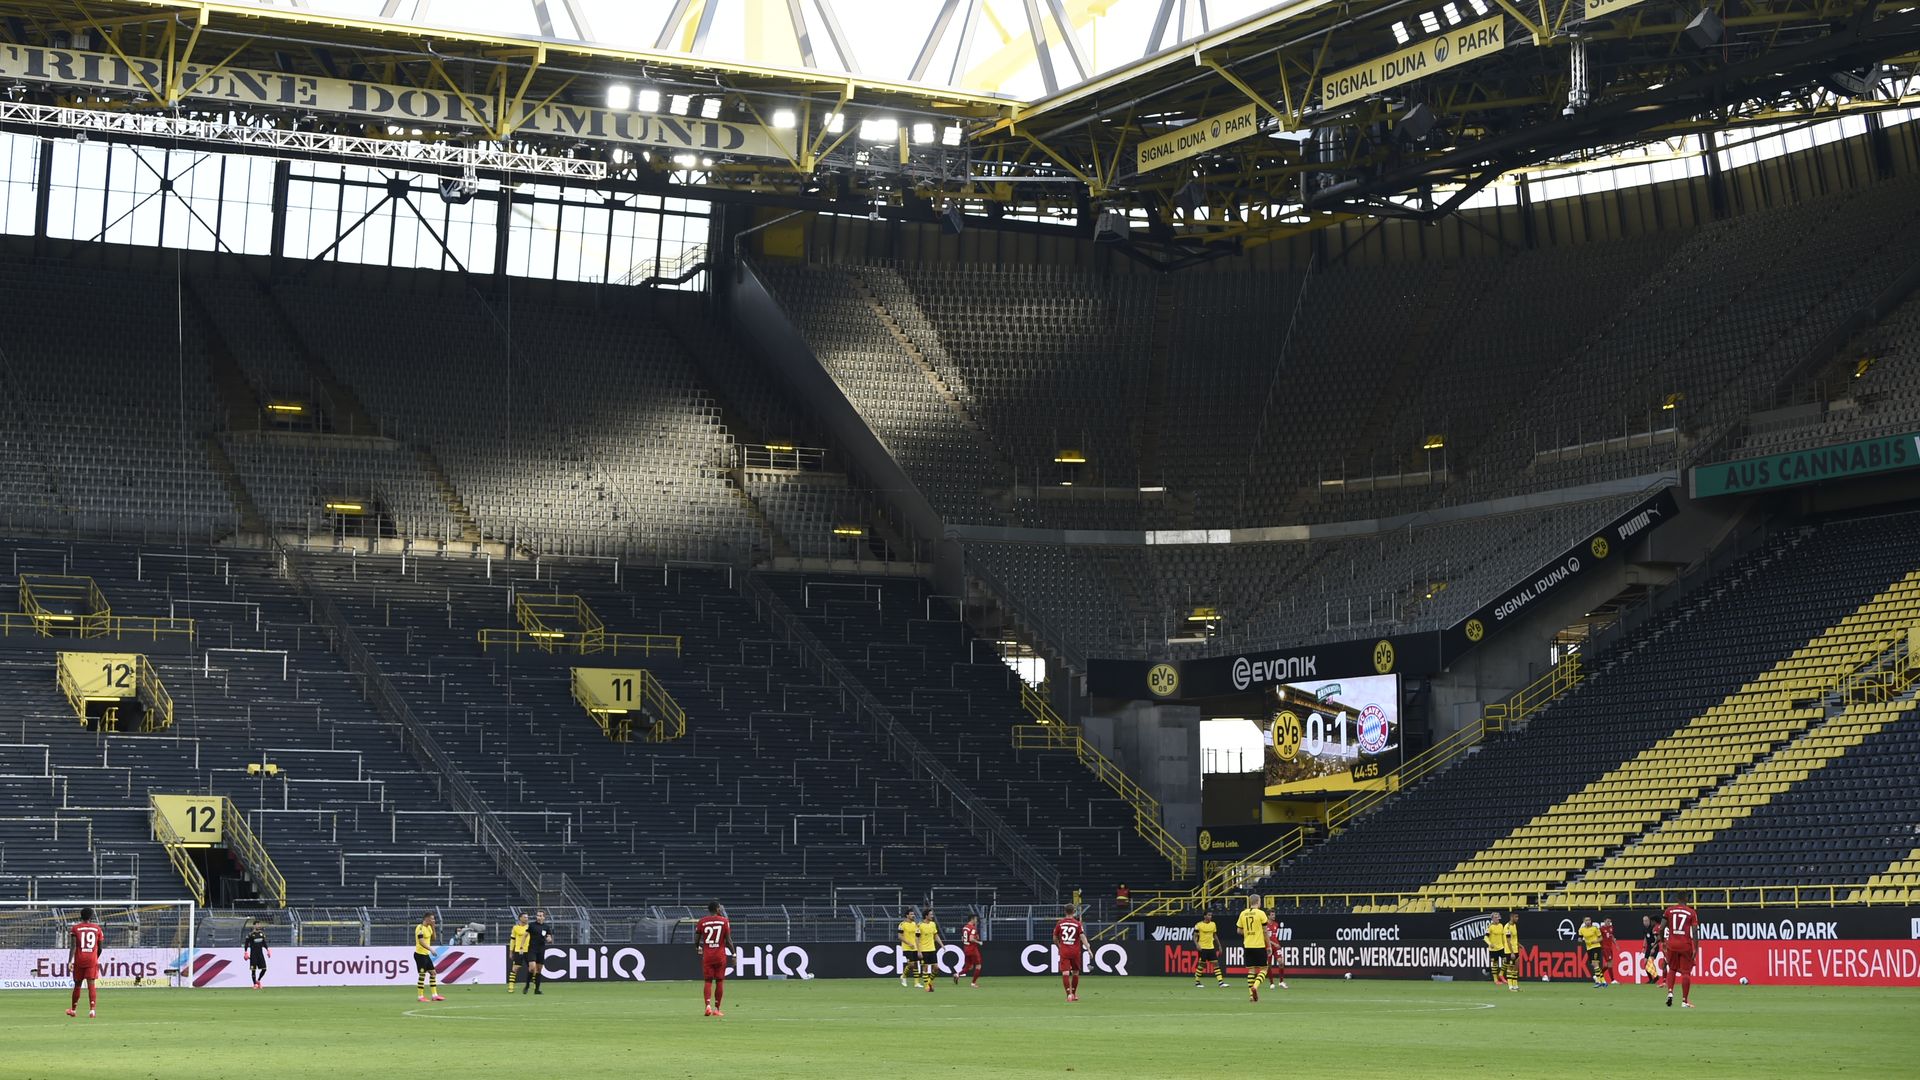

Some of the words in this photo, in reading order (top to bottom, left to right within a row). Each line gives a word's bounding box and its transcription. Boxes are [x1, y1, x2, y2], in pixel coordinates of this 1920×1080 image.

[1326, 69, 1377, 101] SIGNAL
[1381, 51, 1426, 82] IDUNA
[1458, 24, 1500, 55] PARK
[348, 83, 744, 150] DORTMUND
[1141, 143, 1175, 164] SIGNAL
[1177, 130, 1207, 151] IDUNA
[1225, 113, 1252, 135] PARK
[1725, 461, 1770, 490] AUS
[1778, 438, 1907, 481] CANNABIS
[1617, 513, 1651, 540] PUMA
[1494, 588, 1536, 621] SIGNAL
[1535, 565, 1570, 595] IDUNA
[1377, 644, 1392, 664] BVB
[102, 663, 130, 688] 12
[1152, 668, 1174, 686] BVB
[1253, 655, 1317, 682] EVONIK
[612, 678, 632, 702] 11
[1277, 717, 1299, 746] BVB
[1284, 745, 1293, 755] 09
[1354, 763, 1379, 780] 44:55
[186, 806, 216, 833] 12
[1060, 925, 1077, 942] 32
[1245, 916, 1254, 932] 17
[1336, 922, 1400, 941] comdirect
[1672, 913, 1687, 931] 17
[1732, 922, 1778, 940] IDUNA
[1797, 922, 1838, 940] PARK
[80, 931, 96, 949] 19
[704, 925, 722, 944] 27
[541, 945, 646, 981] CHiQ
[1165, 944, 1220, 974] Maz
[1303, 943, 1326, 966] FÜR
[1519, 945, 1591, 978] Mazak
[1768, 949, 1812, 977] IHRE
[1818, 949, 1920, 978] VERSAND
[37, 957, 157, 980] Eurwings
[296, 955, 410, 980] Eurowings
[4, 981, 37, 989] SIGNAL
[39, 980, 67, 988] IDUNA
